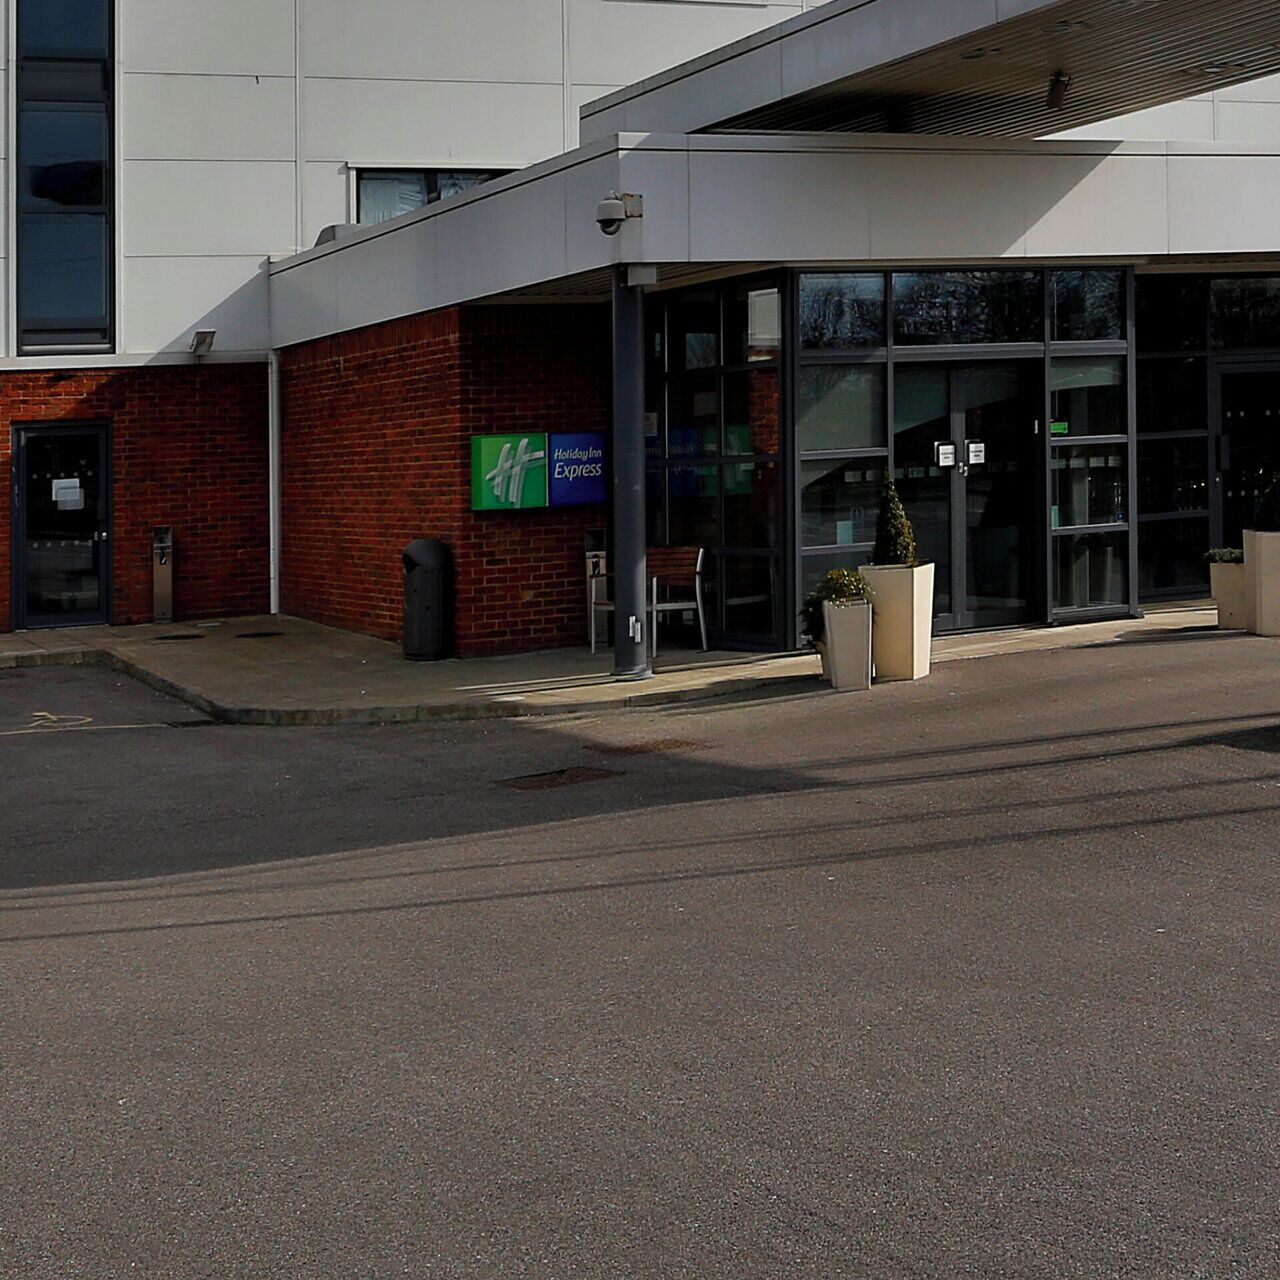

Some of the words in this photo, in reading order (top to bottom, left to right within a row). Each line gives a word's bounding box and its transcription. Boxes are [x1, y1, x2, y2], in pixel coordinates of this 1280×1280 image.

[554, 448, 588, 461] Holiday
[589, 446, 602, 458] Inn
[554, 462, 602, 481] Express
